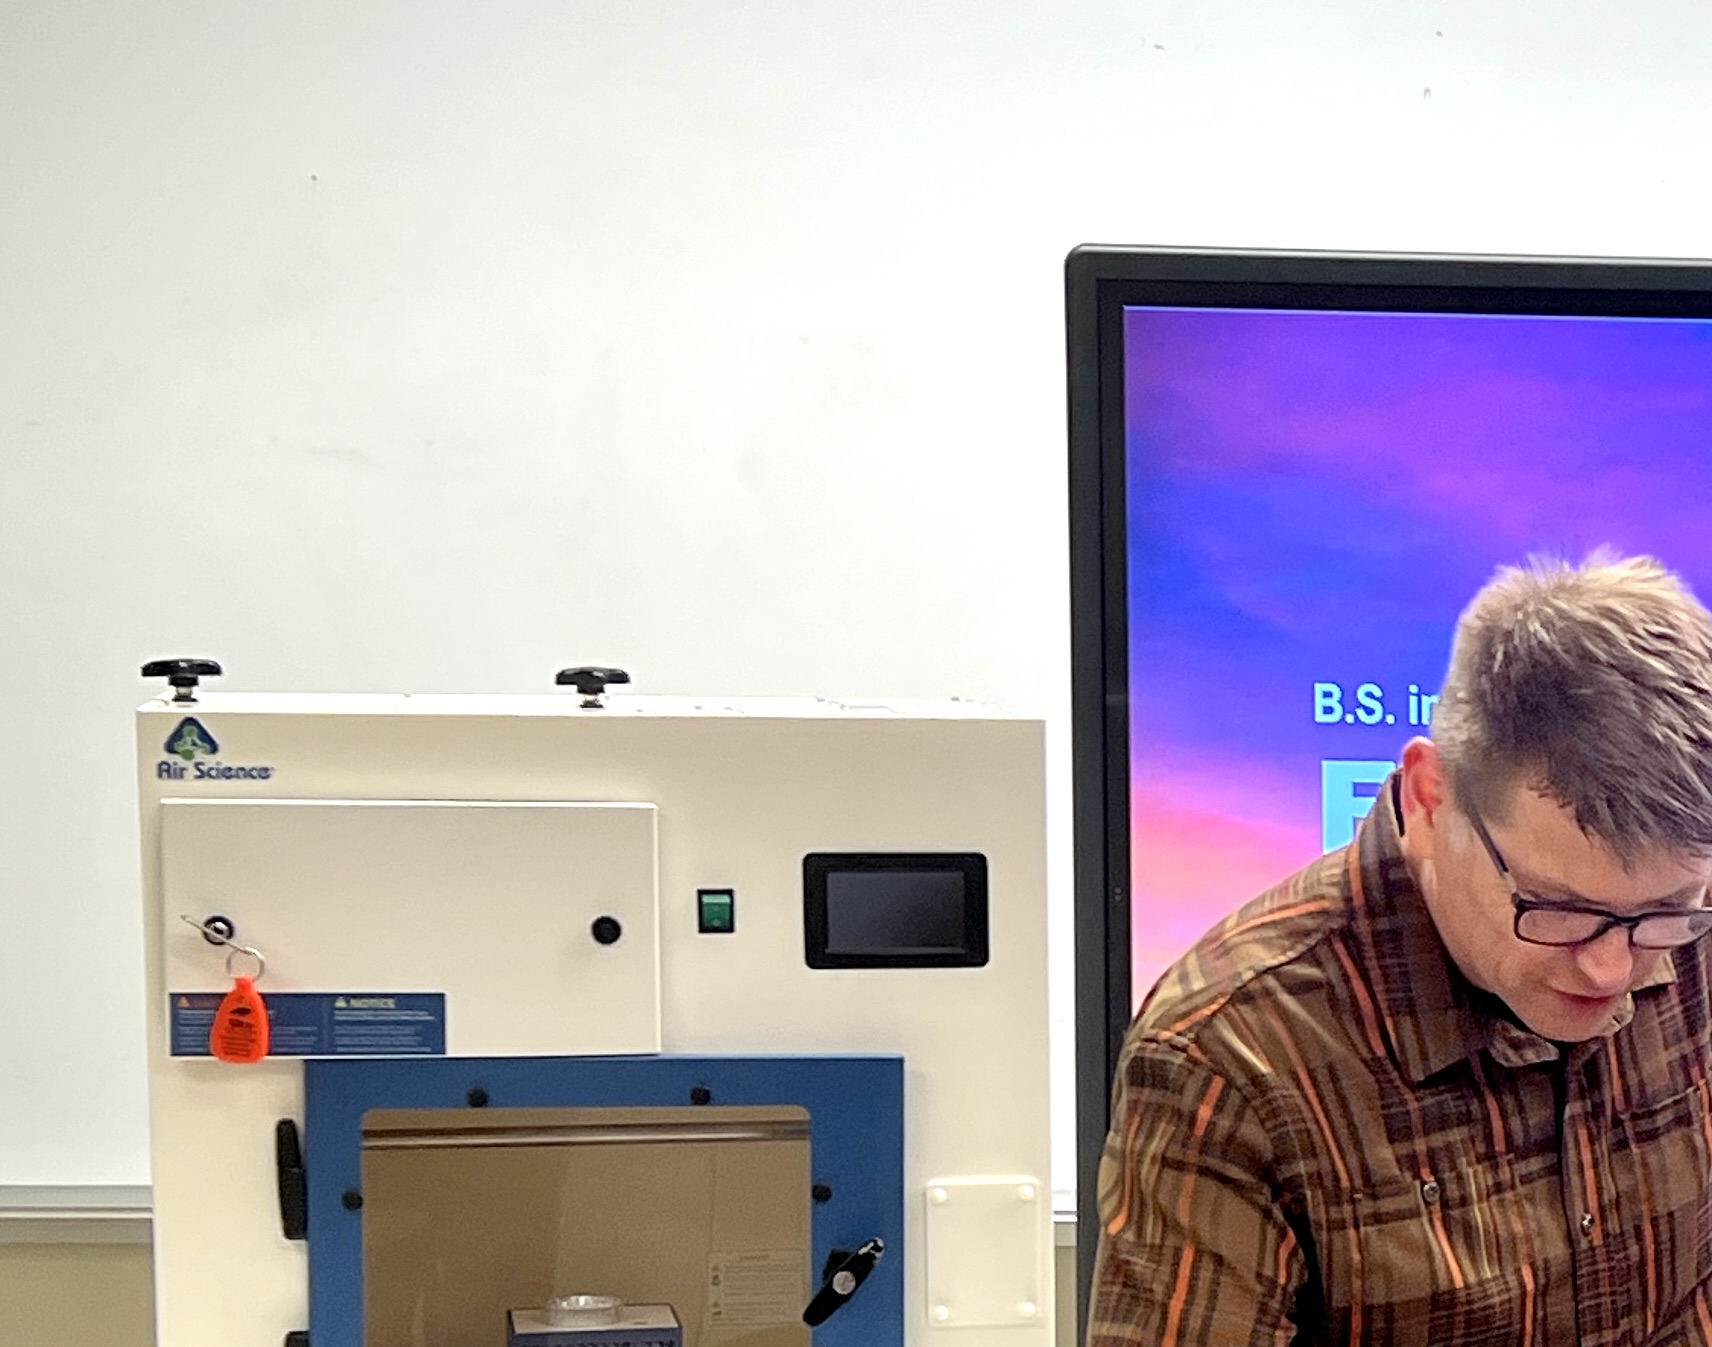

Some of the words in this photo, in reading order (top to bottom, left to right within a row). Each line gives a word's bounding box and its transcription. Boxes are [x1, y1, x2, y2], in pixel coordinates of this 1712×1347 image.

[1314, 682, 1396, 725] B.S.
[157, 761, 187, 780] Air
[194, 761, 271, 780] Science
